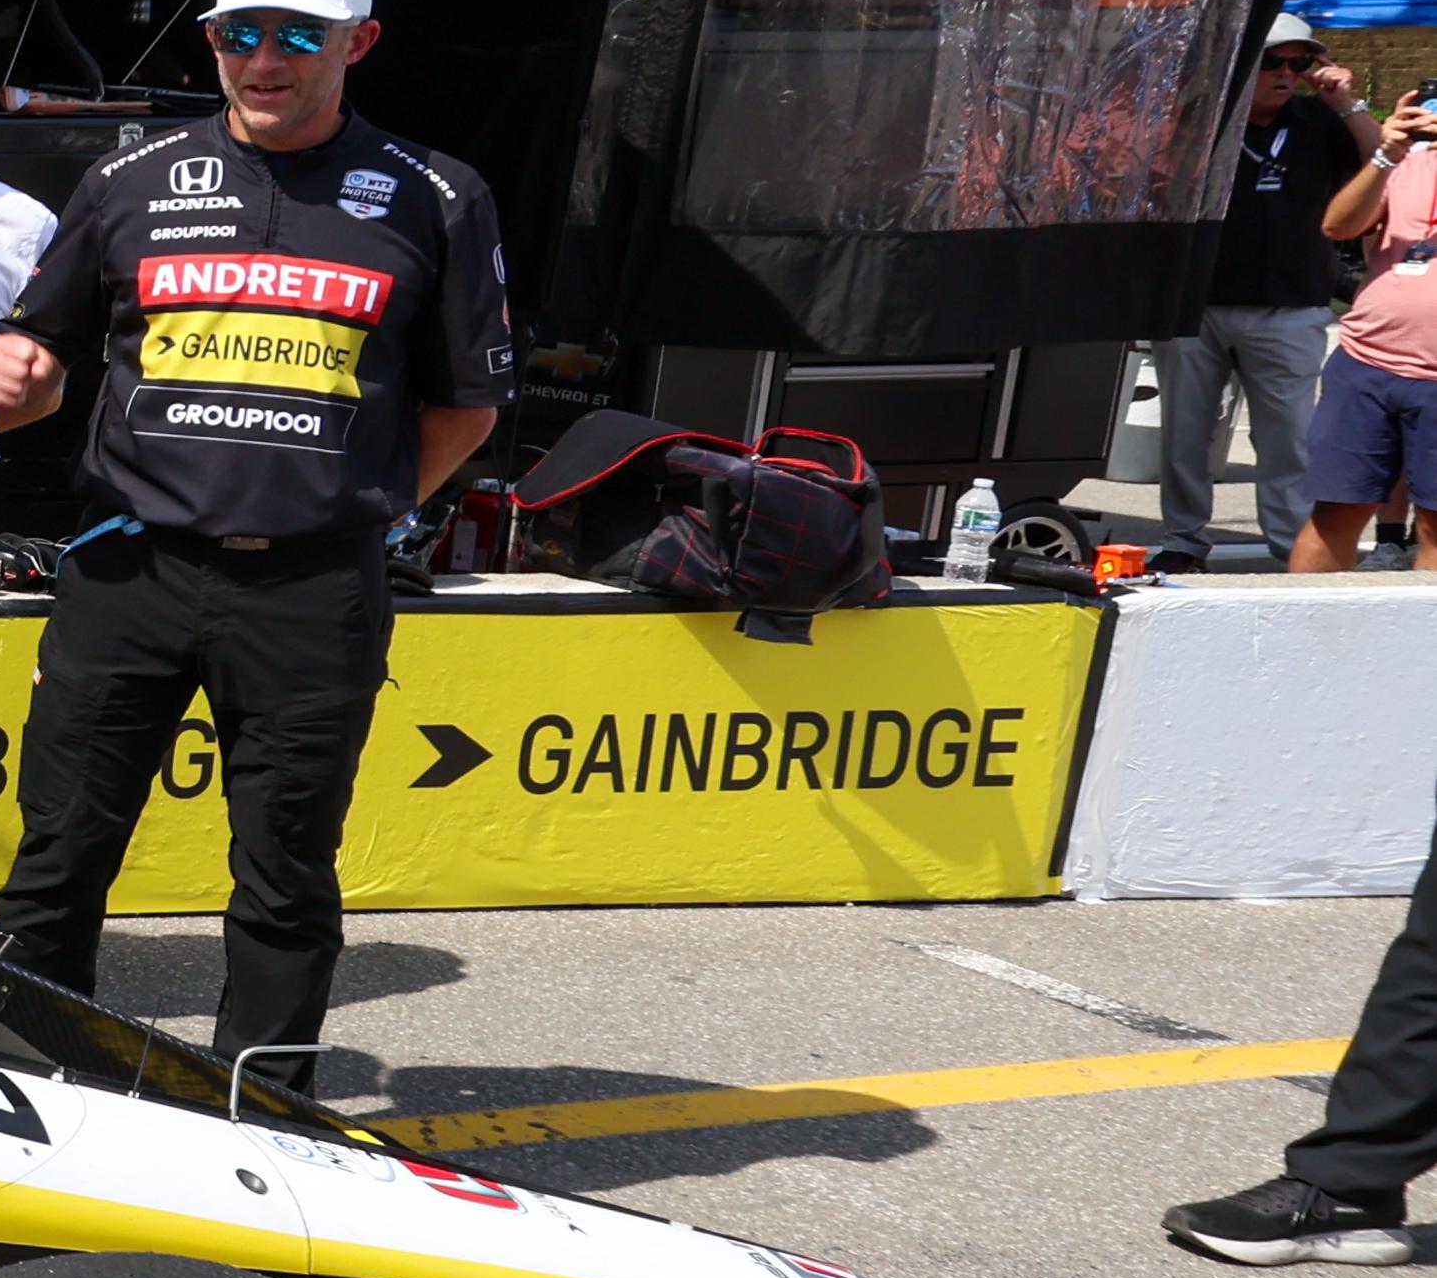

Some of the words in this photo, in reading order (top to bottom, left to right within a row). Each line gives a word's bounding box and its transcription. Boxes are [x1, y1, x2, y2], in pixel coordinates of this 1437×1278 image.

[101, 130, 189, 178] Firestone
[383, 142, 458, 202] Firestone
[148, 196, 243, 213] HONDA
[341, 186, 393, 204] INDYCAR
[150, 225, 236, 241] GROUP1001
[152, 262, 379, 313] ANDRETTI
[182, 331, 350, 373] GAINBRIDGE
[167, 402, 321, 436] GROUP1001
[518, 708, 1025, 796] GAINBRIDGE
